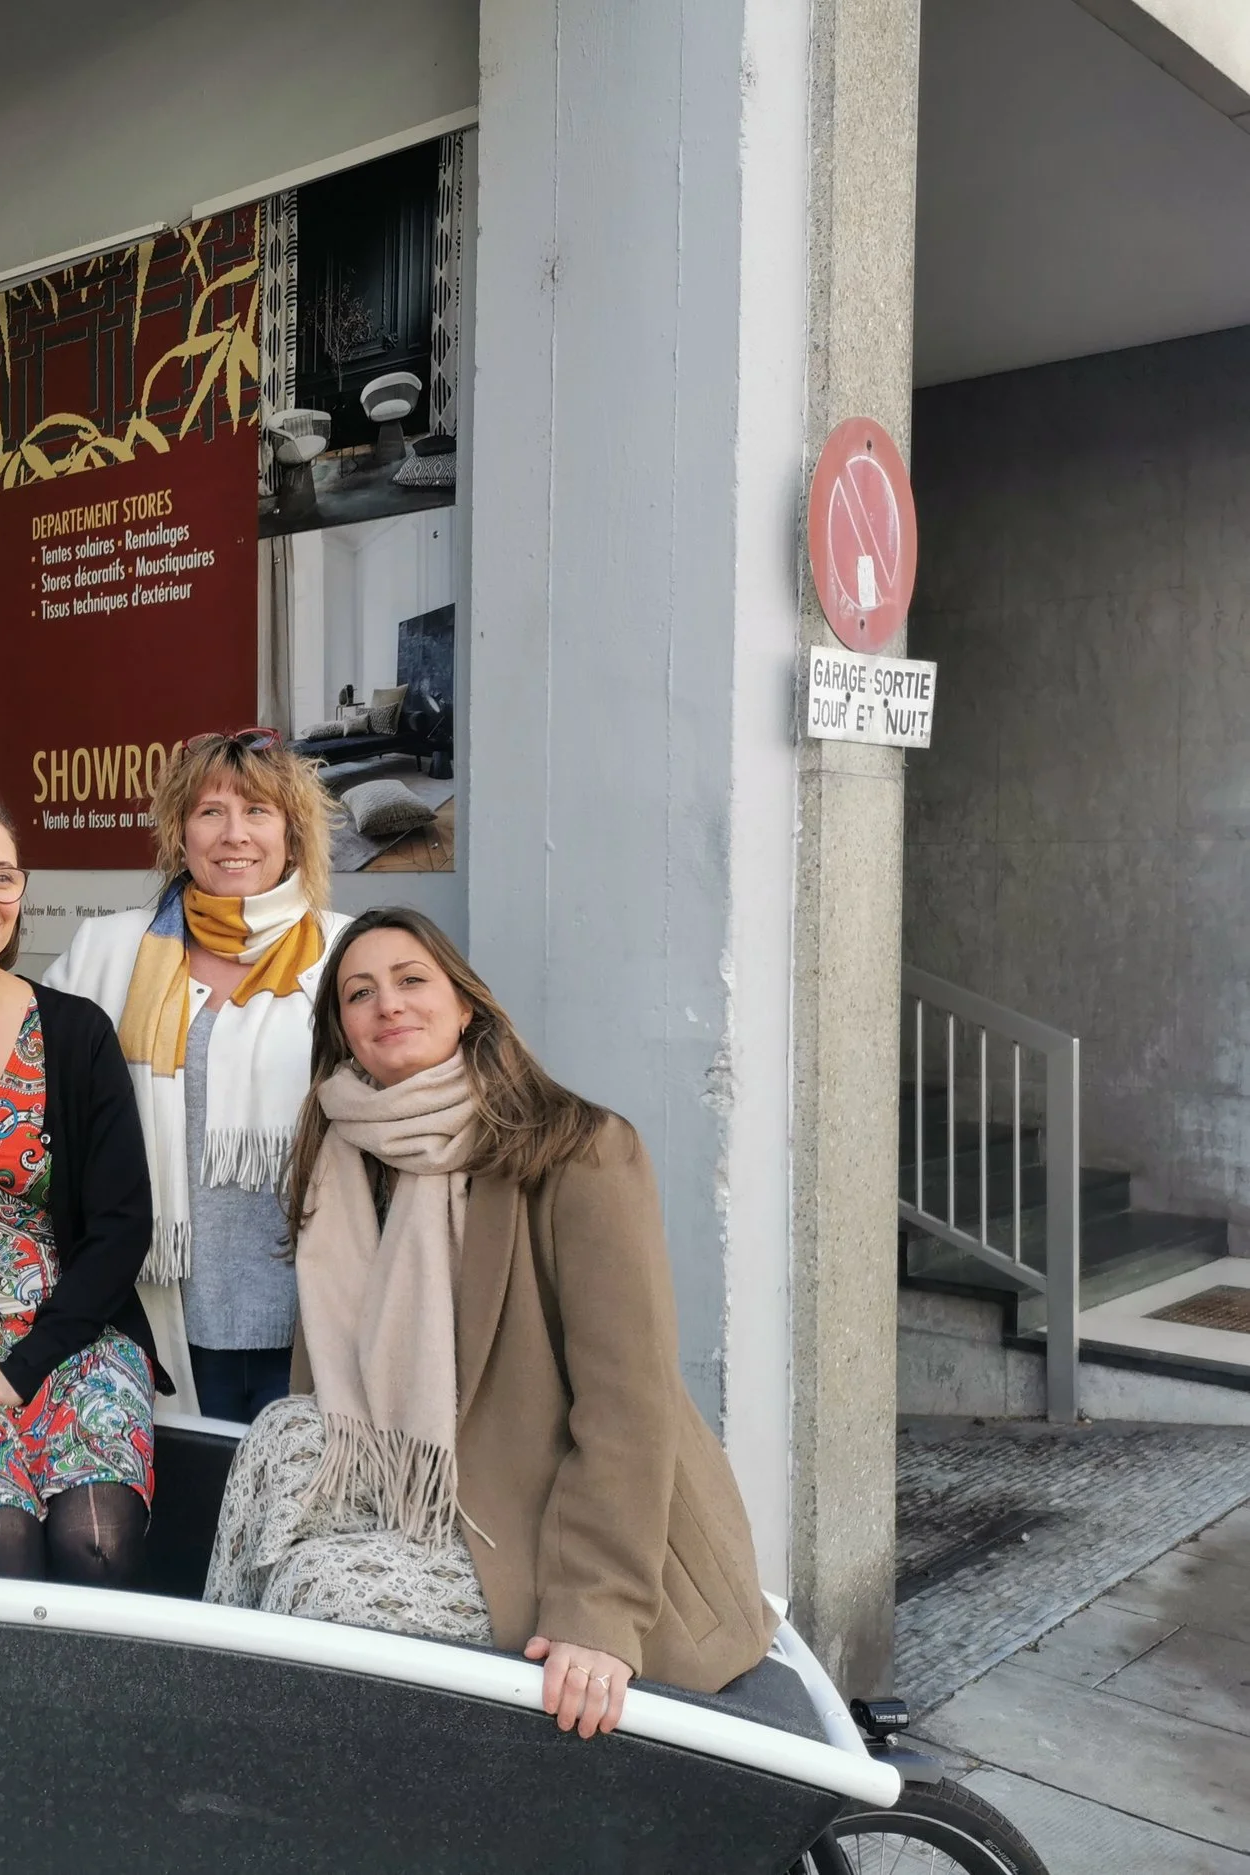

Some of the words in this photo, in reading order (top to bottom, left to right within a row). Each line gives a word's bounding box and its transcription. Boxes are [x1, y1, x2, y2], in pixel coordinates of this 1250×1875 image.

[32, 500, 119, 540] DEPARTEMENT
[123, 489, 173, 523] STORES
[41, 544, 72, 566] Tentes
[75, 536, 115, 560] solaires
[125, 522, 190, 550] Rentoilages
[41, 572, 71, 593] Stores
[74, 558, 125, 587] décoratifs
[135, 548, 215, 578] Moustiquaires
[41, 599, 70, 620] Tissus
[73, 592, 128, 616] techniques
[132, 580, 192, 607] d'extérieur
[814, 659, 866, 693] GARAGE
[874, 669, 931, 700] SORTIE
[812, 698, 847, 729] JOUR
[856, 704, 874, 731] ET
[886, 708, 928, 738] NUIT
[42, 809, 70, 830] Vente
[72, 807, 85, 829] de
[88, 809, 117, 829] tissus
[119, 813, 133, 828] au
[23, 904, 45, 916] Andrew
[46, 905, 66, 917] Martin
[75, 905, 96, 917] Winter
